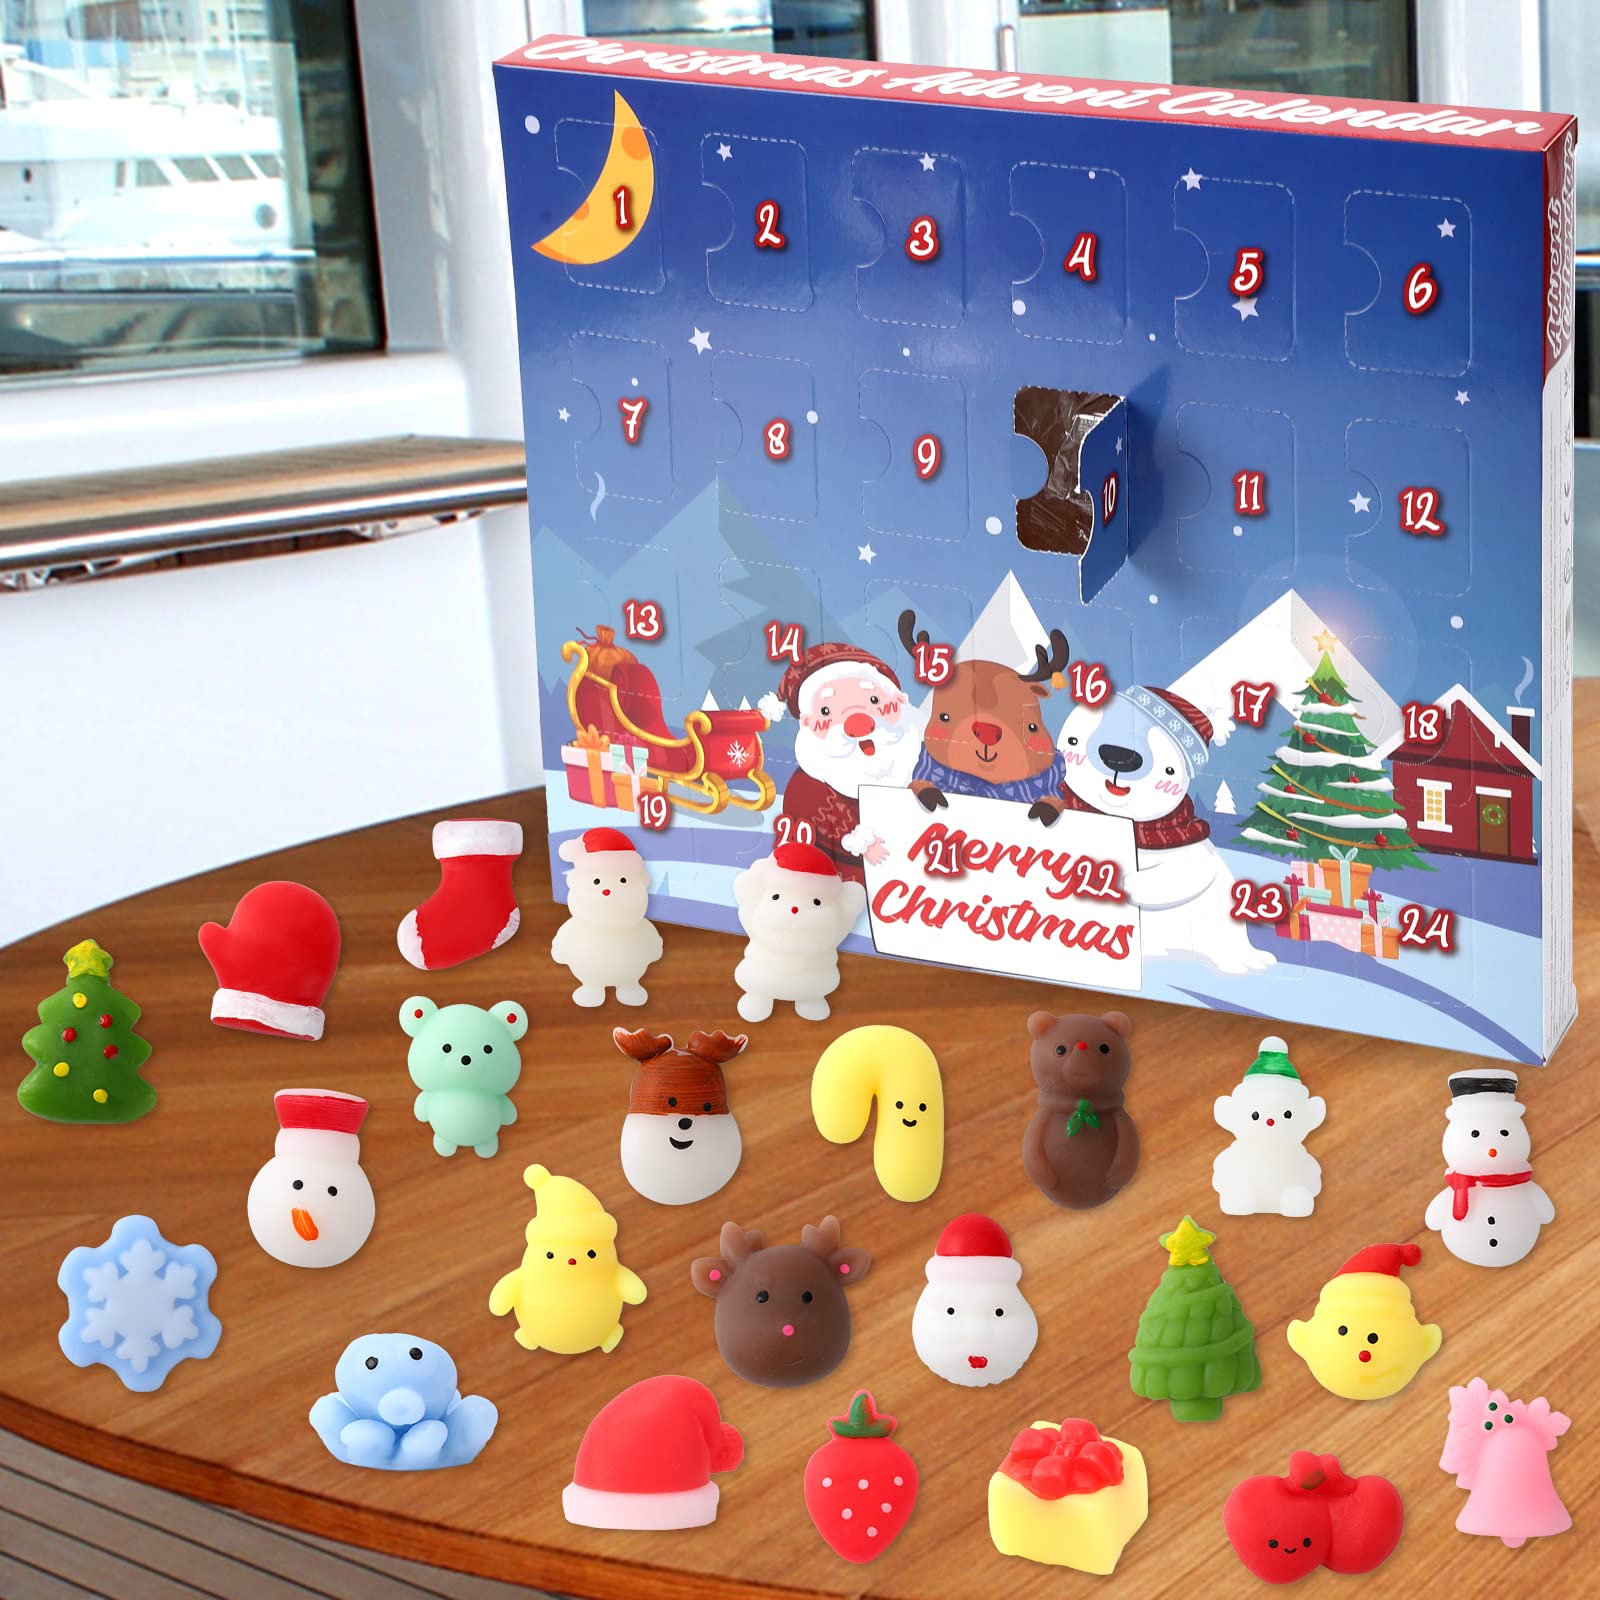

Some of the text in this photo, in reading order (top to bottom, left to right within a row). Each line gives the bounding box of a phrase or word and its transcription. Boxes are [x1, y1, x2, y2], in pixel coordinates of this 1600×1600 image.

[522, 38, 884, 88] Christmas
[884, 70, 1172, 111] Advent
[613, 187, 631, 227] 1
[757, 203, 783, 246] 2
[907, 218, 936, 258] 3
[1066, 235, 1094, 278] 4
[1561, 130, 1574, 341] Calendar
[1232, 249, 1261, 293] 5
[1406, 265, 1435, 311] 6
[1547, 197, 1562, 359] Advent
[619, 399, 645, 441] 7
[765, 420, 788, 457] 8
[915, 435, 938, 477] 9
[1101, 475, 1118, 519] 10
[1235, 471, 1263, 512] 11
[1400, 488, 1442, 533] 12
[624, 600, 661, 639] 13
[766, 622, 802, 664] 14
[914, 643, 951, 684] 15
[1070, 663, 1109, 705] 16
[1232, 682, 1273, 725] 17
[1404, 703, 1441, 743] 18
[639, 792, 669, 830] 19
[775, 815, 815, 843] 20
[907, 822, 1097, 899] Merry
[925, 836, 962, 875] 21
[1073, 858, 1124, 901] 22
[1232, 880, 1286, 921] 23
[872, 879, 1134, 960] Christmas
[1399, 905, 1452, 950] 24
